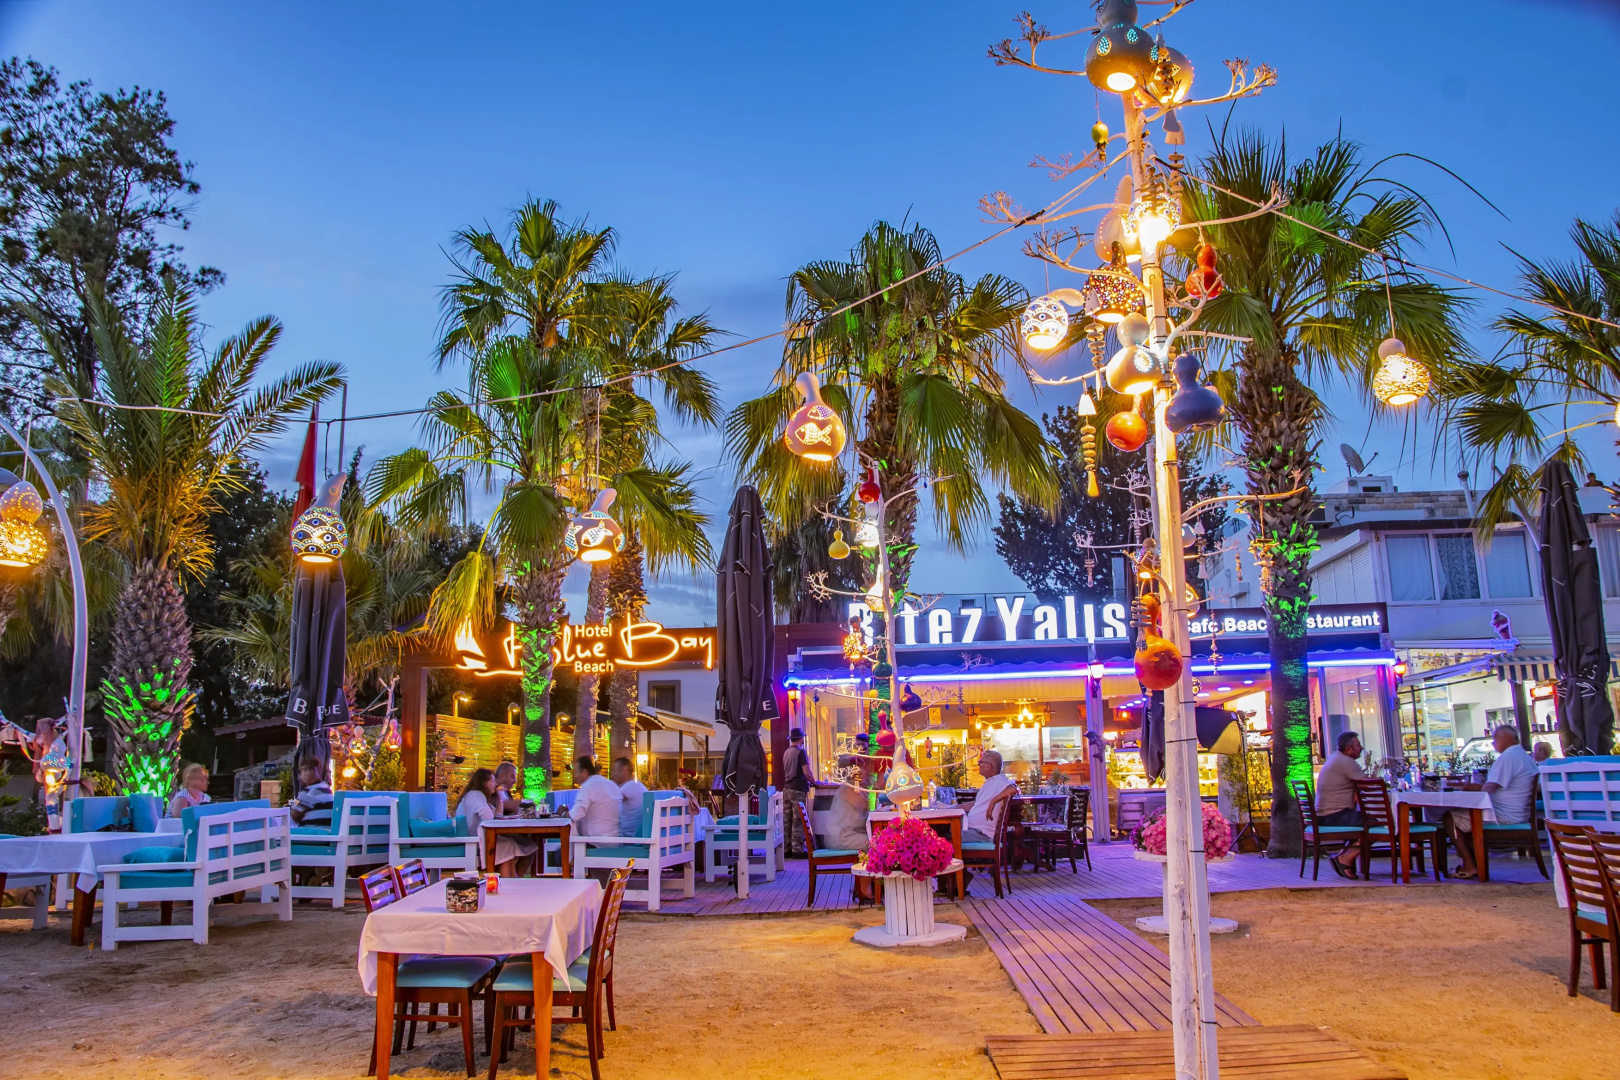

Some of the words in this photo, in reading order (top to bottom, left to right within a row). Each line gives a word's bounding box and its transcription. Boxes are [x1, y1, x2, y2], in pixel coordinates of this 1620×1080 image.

[574, 623, 613, 637] Hotel
[1224, 617, 1267, 632] Beac
[614, 612, 713, 671] Bay
[574, 660, 614, 673] Beach
